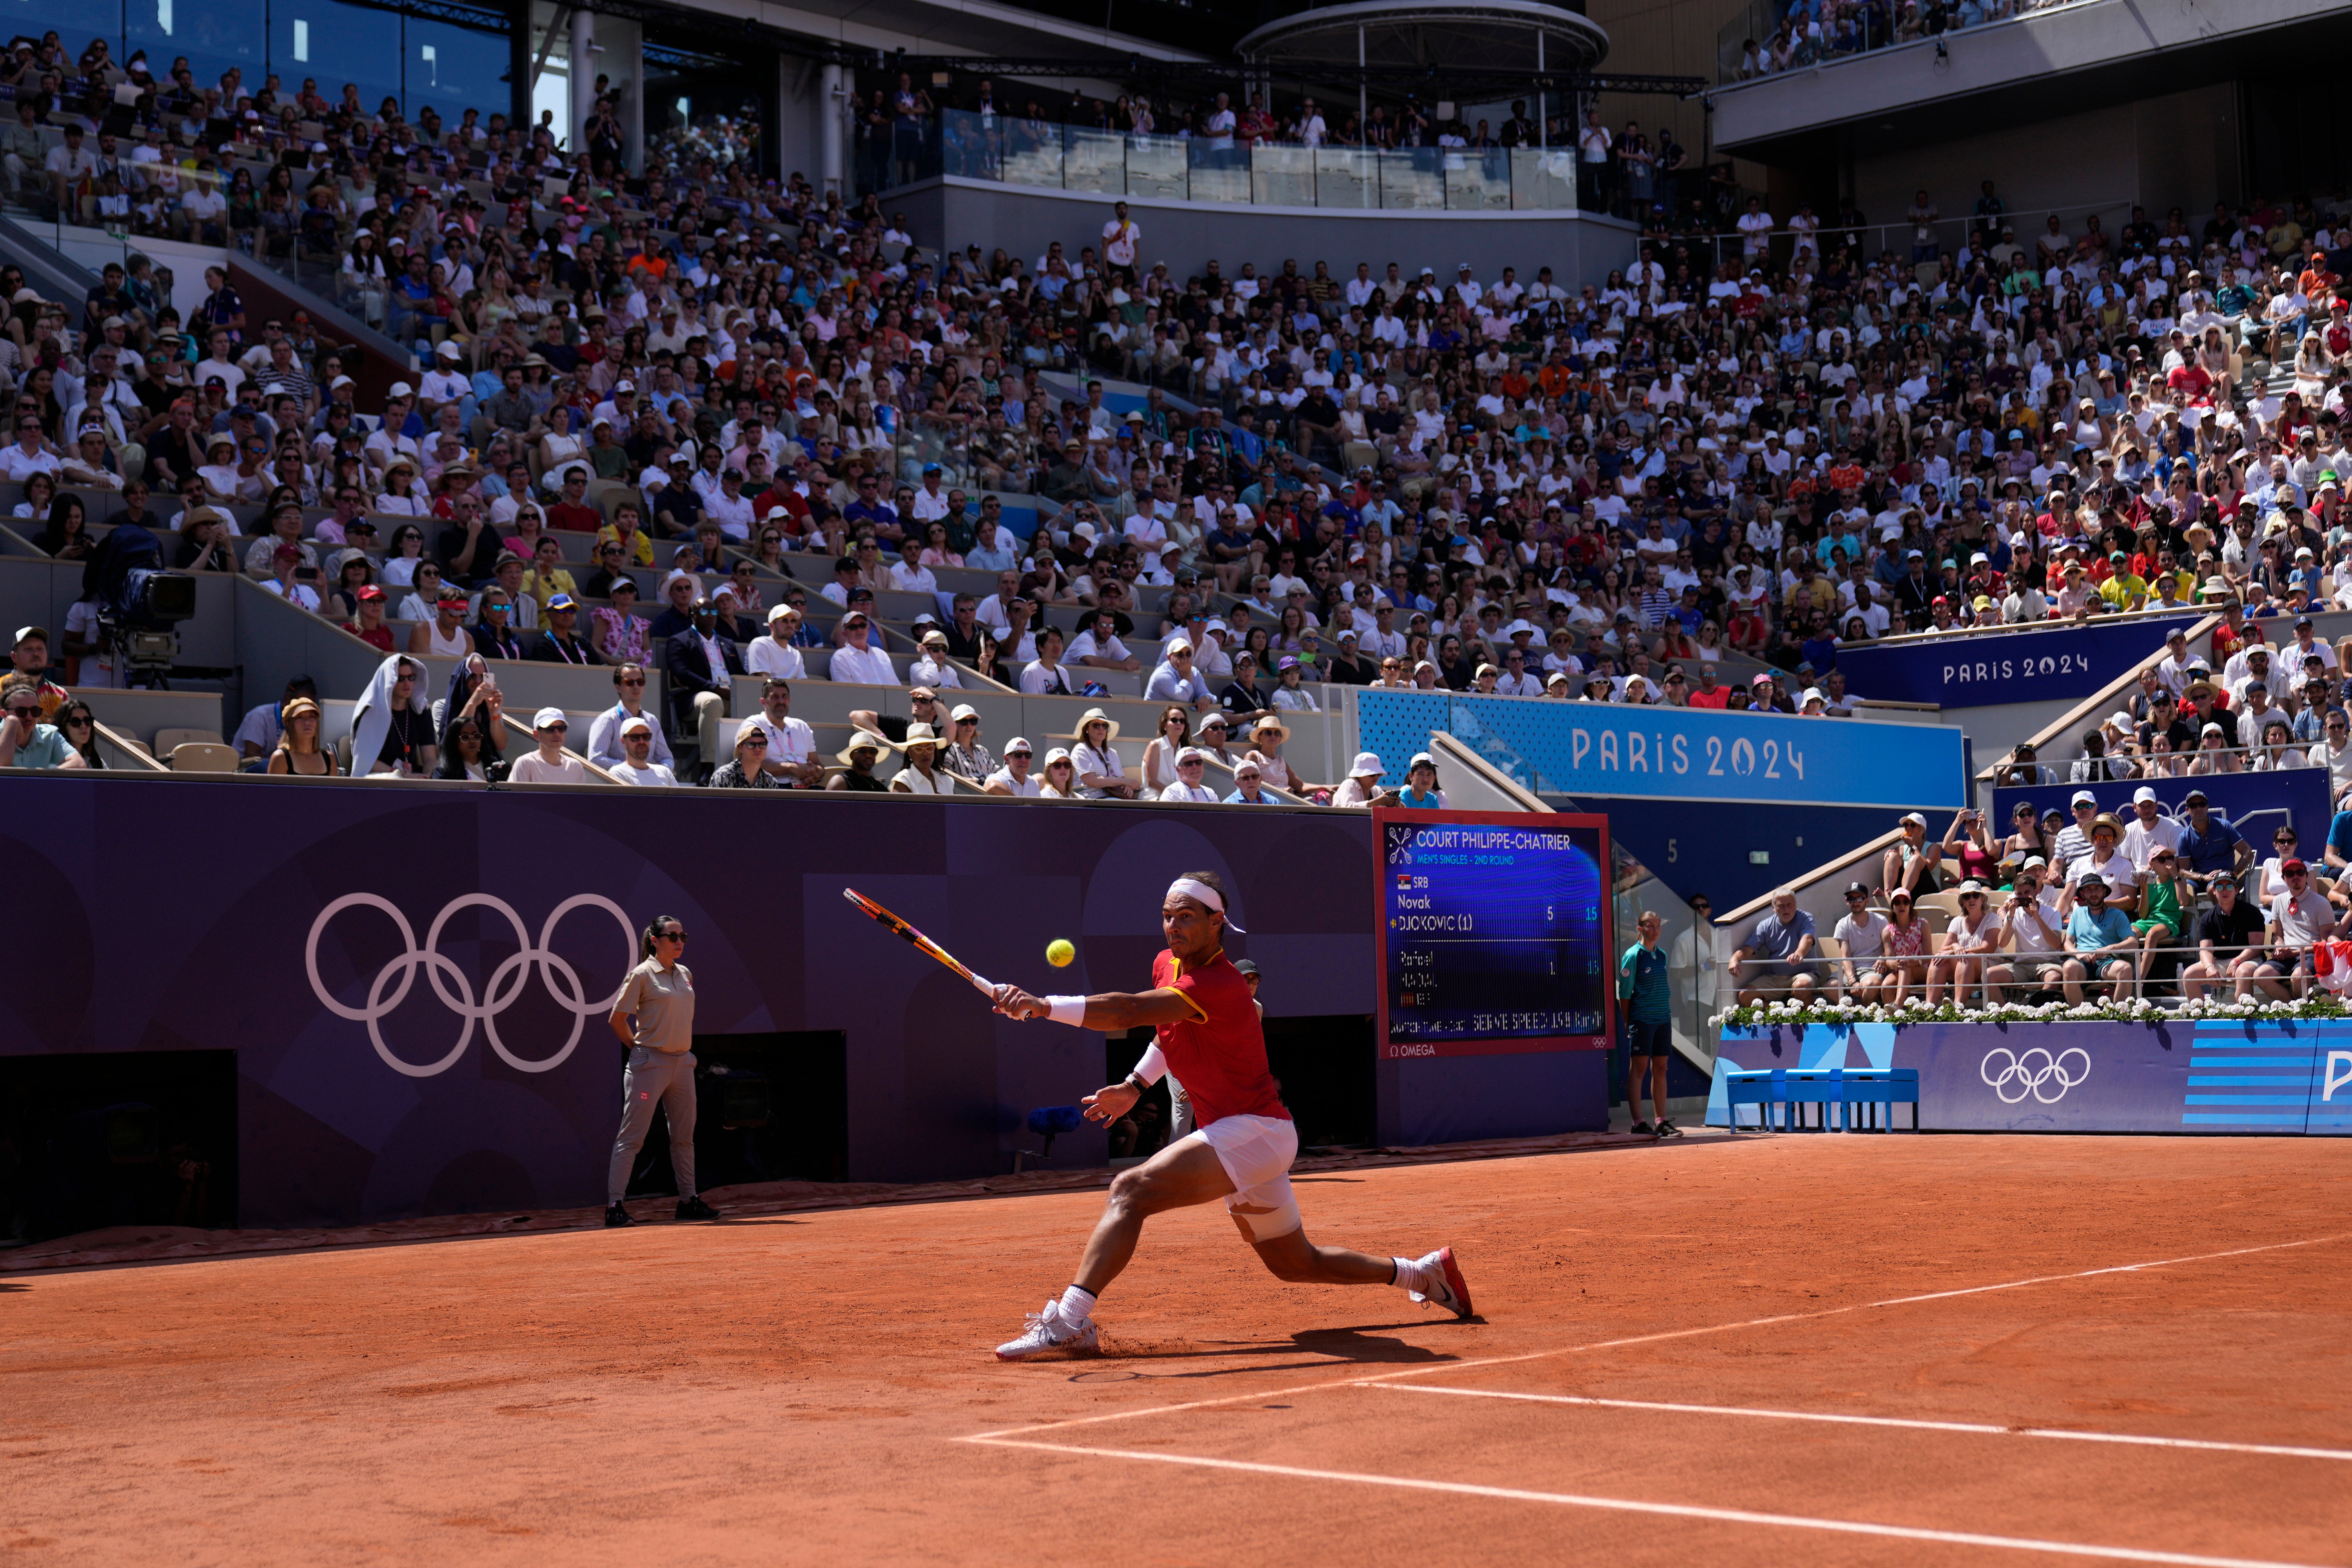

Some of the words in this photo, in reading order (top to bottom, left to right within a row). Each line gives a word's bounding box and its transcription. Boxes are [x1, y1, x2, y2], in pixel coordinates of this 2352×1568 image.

[2024, 653, 2088, 677] 2024
[1706, 736, 1803, 780] 2024
[1417, 831, 1459, 848] COURT
[1463, 831, 1570, 850] PHILIPPE-CHATRIER
[1668, 838, 1677, 863] 5
[1417, 854, 1438, 864] MEN'S
[1440, 854, 1468, 864] SINGLES
[1474, 855, 1488, 865] 2ND
[1490, 855, 1514, 865] ROUND
[1413, 877, 1429, 888] SRB
[1398, 894, 1431, 909] Novak
[1548, 906, 1553, 921] 5
[1586, 906, 1597, 921] 15
[1399, 915, 1455, 931] DJOKOVIC
[1458, 914, 1473, 932] (1)
[1400, 1044, 1436, 1056] OMEGA
